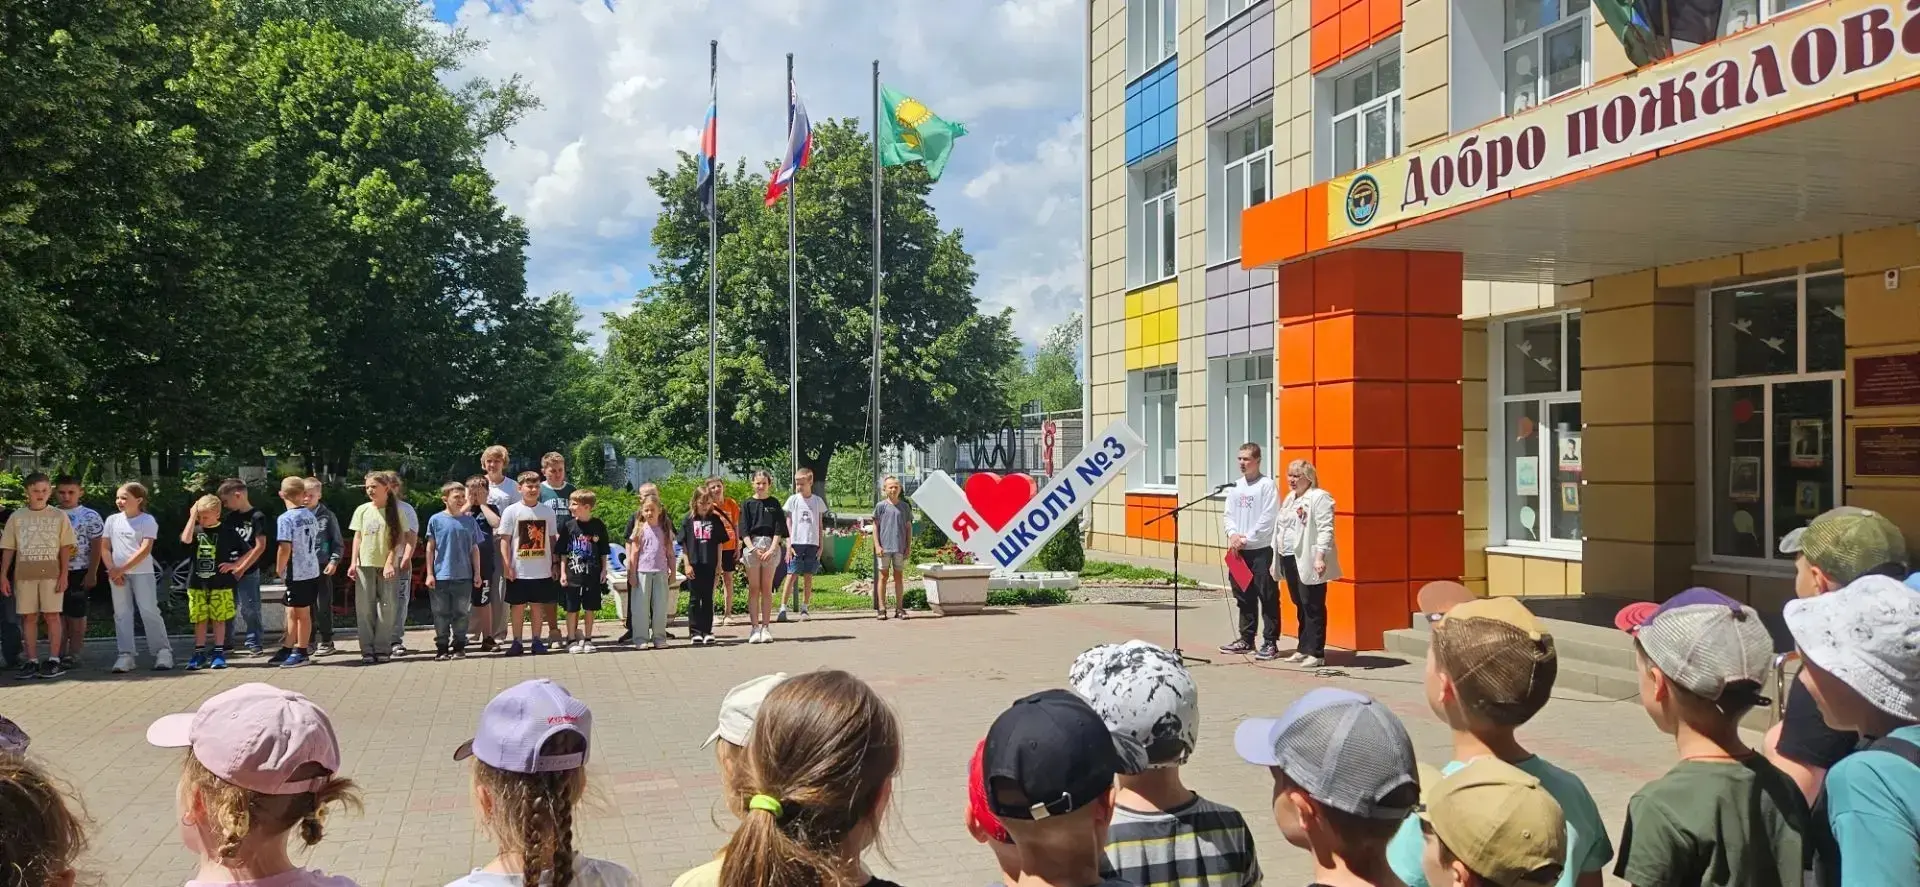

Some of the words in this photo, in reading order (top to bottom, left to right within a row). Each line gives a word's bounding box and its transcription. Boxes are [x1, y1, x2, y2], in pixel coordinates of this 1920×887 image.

[1401, 124, 1546, 211] Добро
[952, 511, 979, 542] Я
[990, 477, 1077, 568] ШКОЛУ
[1075, 436, 1126, 486] №3
